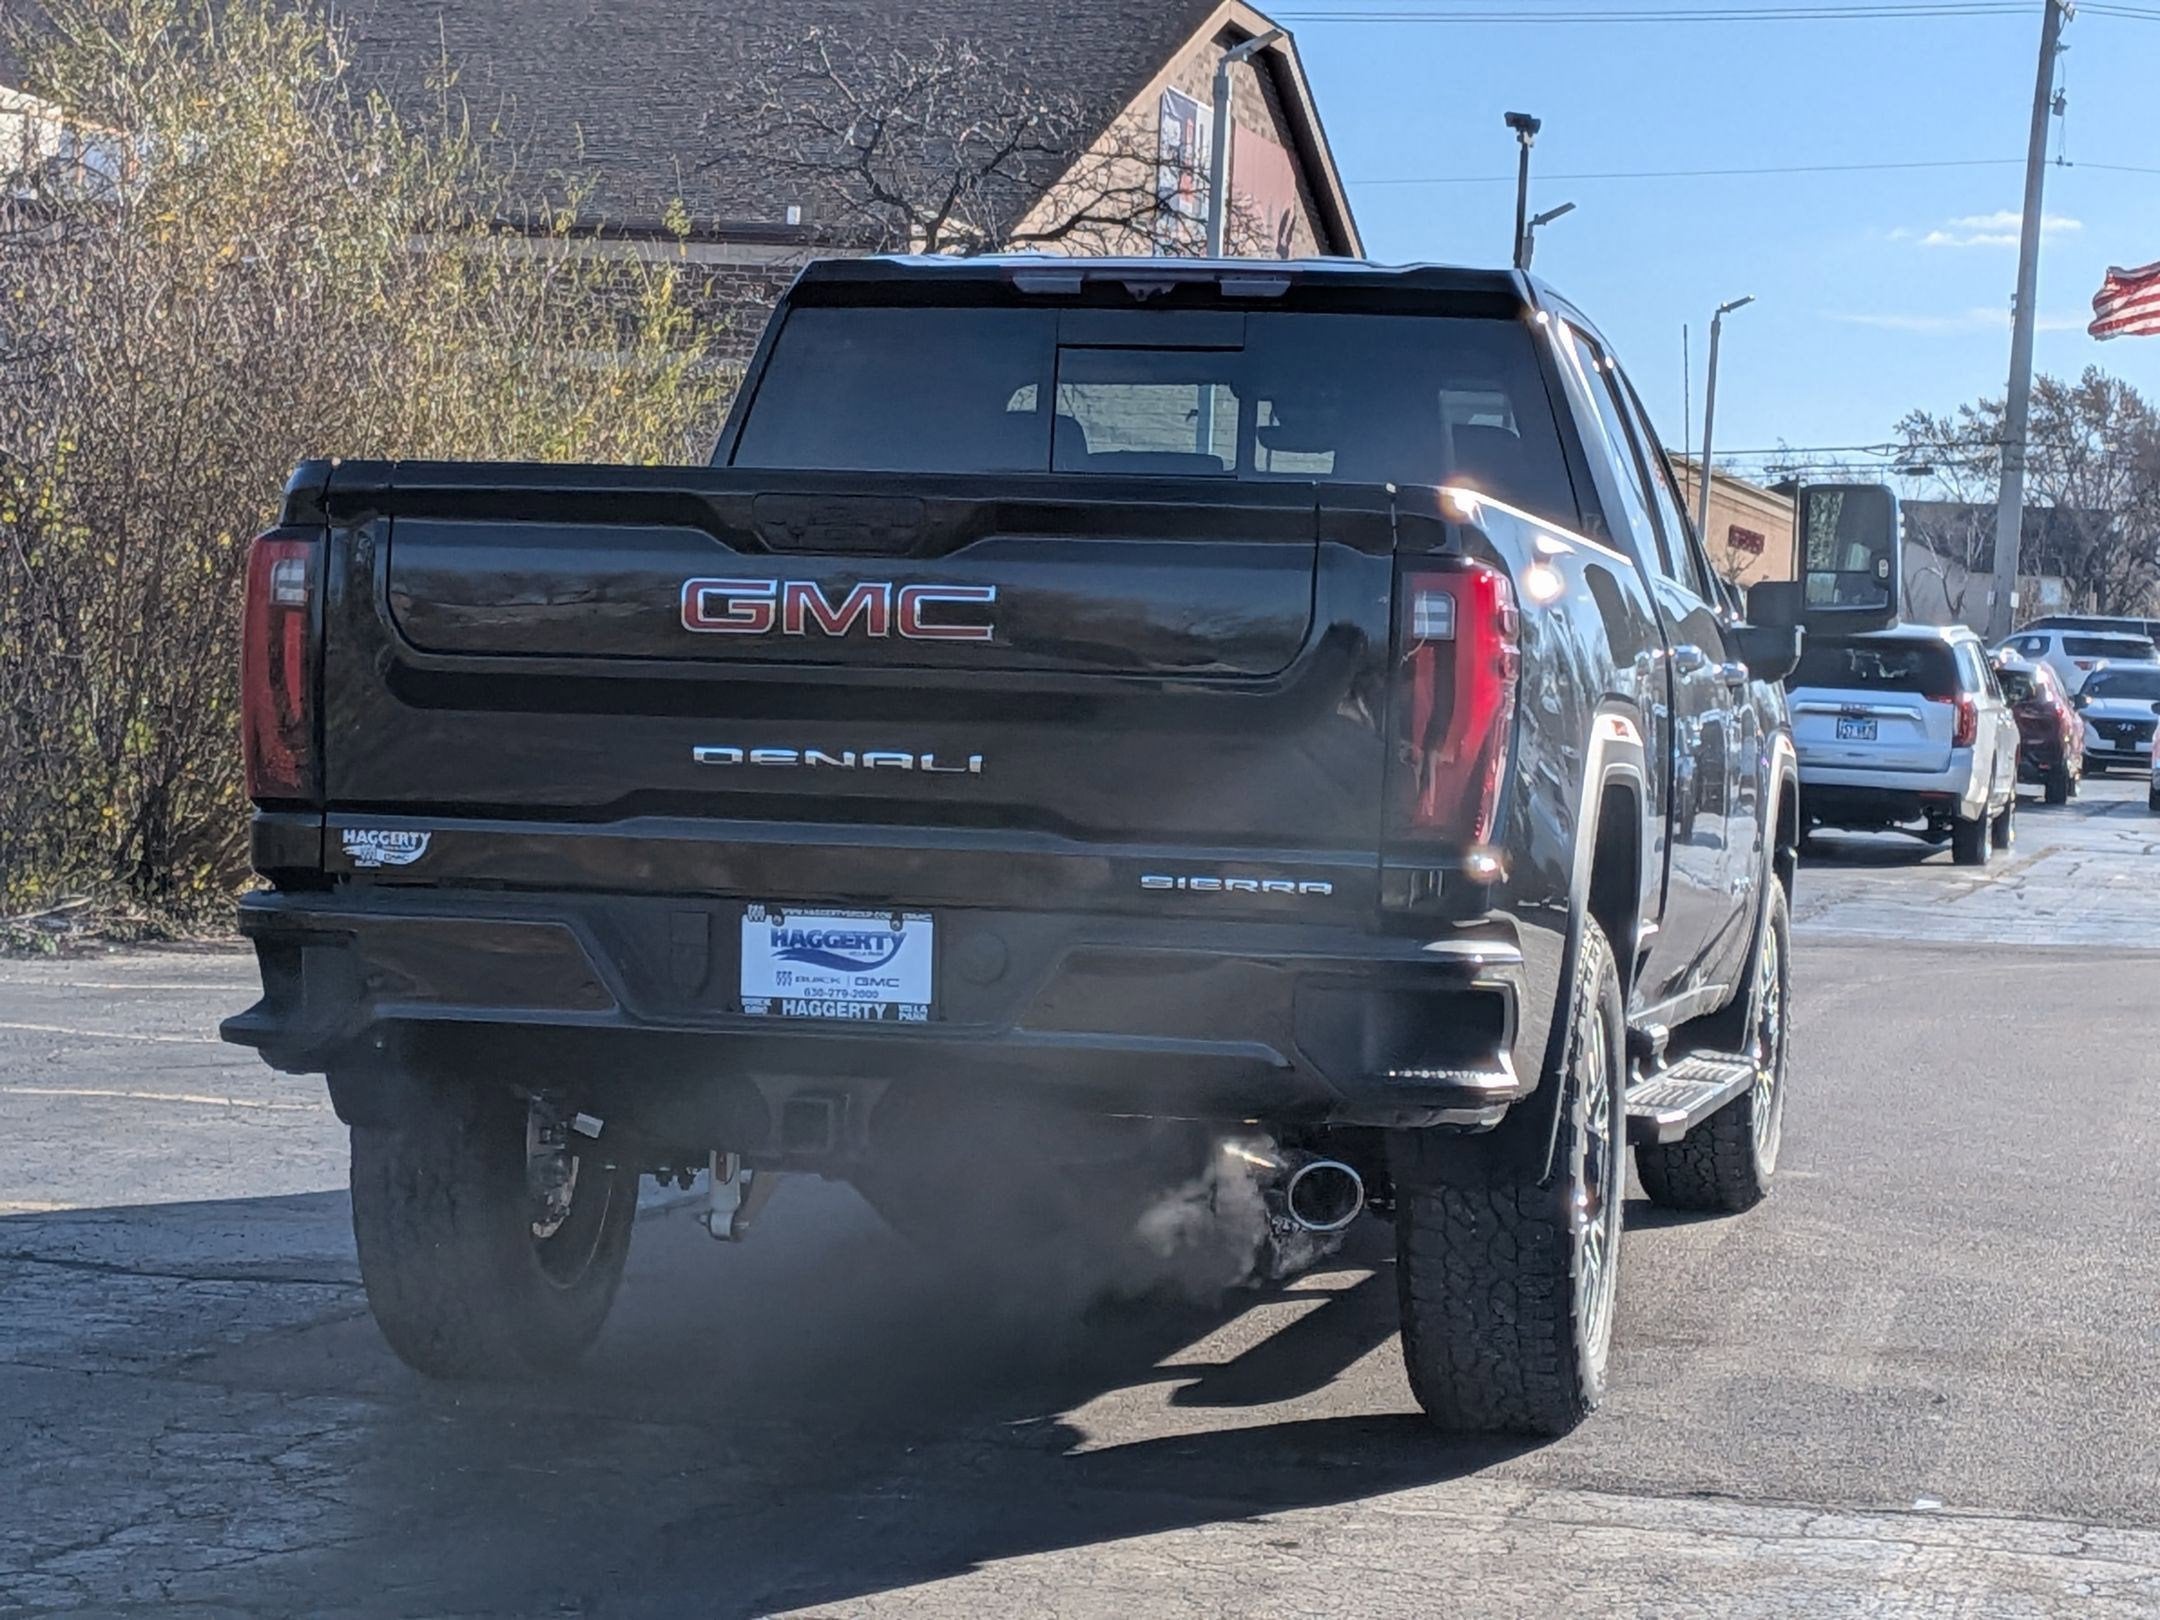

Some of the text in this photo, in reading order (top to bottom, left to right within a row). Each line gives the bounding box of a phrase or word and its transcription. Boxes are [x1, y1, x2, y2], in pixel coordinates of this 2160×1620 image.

[681, 577, 996, 641] GMC
[693, 746, 984, 774] DENALI
[342, 829, 432, 848] HAGGERTY
[1141, 875, 1333, 895] SIERRA
[771, 928, 907, 951] HAGGERTY
[795, 976, 900, 988] BUICK GMC
[804, 987, 879, 999] 630-279-2000
[782, 999, 887, 1020] HAGGERTY
